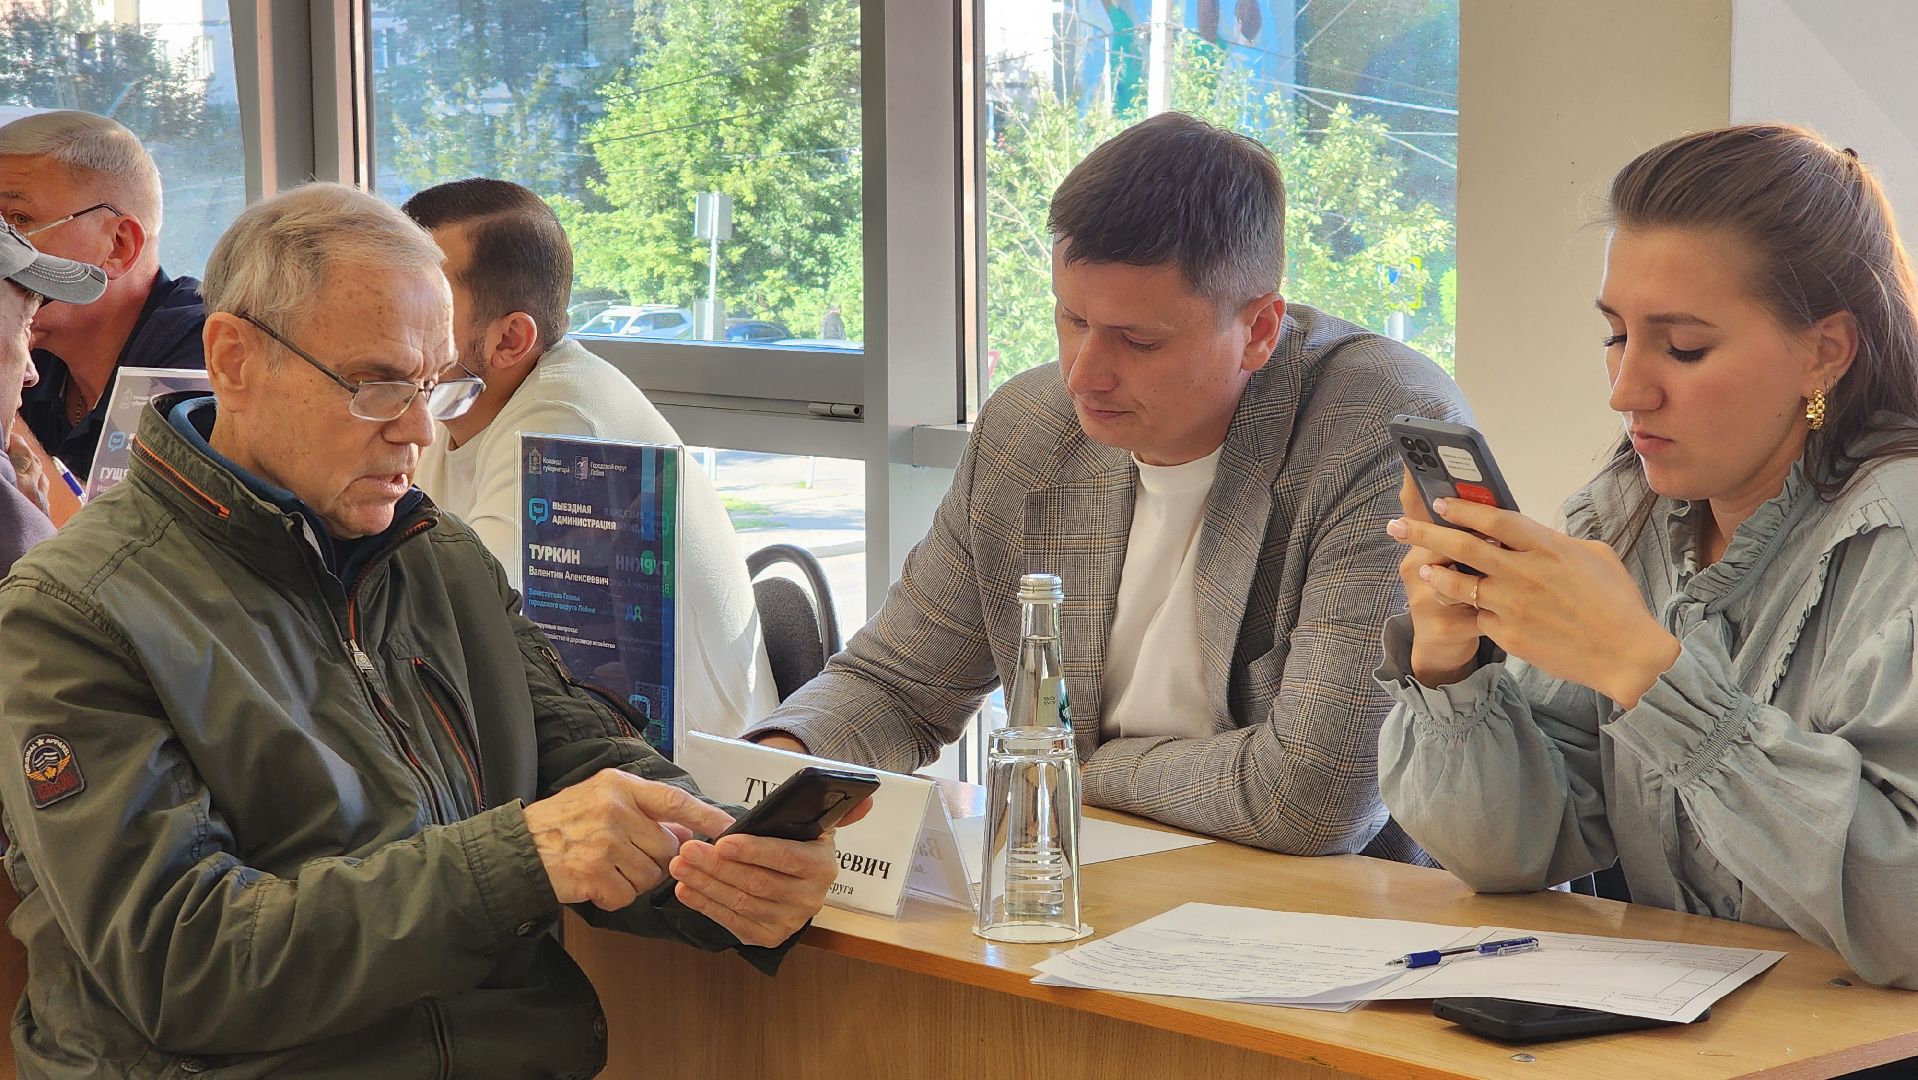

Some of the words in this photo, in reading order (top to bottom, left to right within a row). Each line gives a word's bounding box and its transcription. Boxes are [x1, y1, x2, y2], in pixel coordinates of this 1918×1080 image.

[552, 501, 592, 514] ВЫЕЗДНАЯ
[552, 515, 617, 531] АДМИНИСТРАЦИЯ
[528, 543, 581, 565] ТУРКИН
[528, 565, 564, 580] Валентин
[564, 570, 609, 586] Алексеевич
[528, 598, 559, 609] городского
